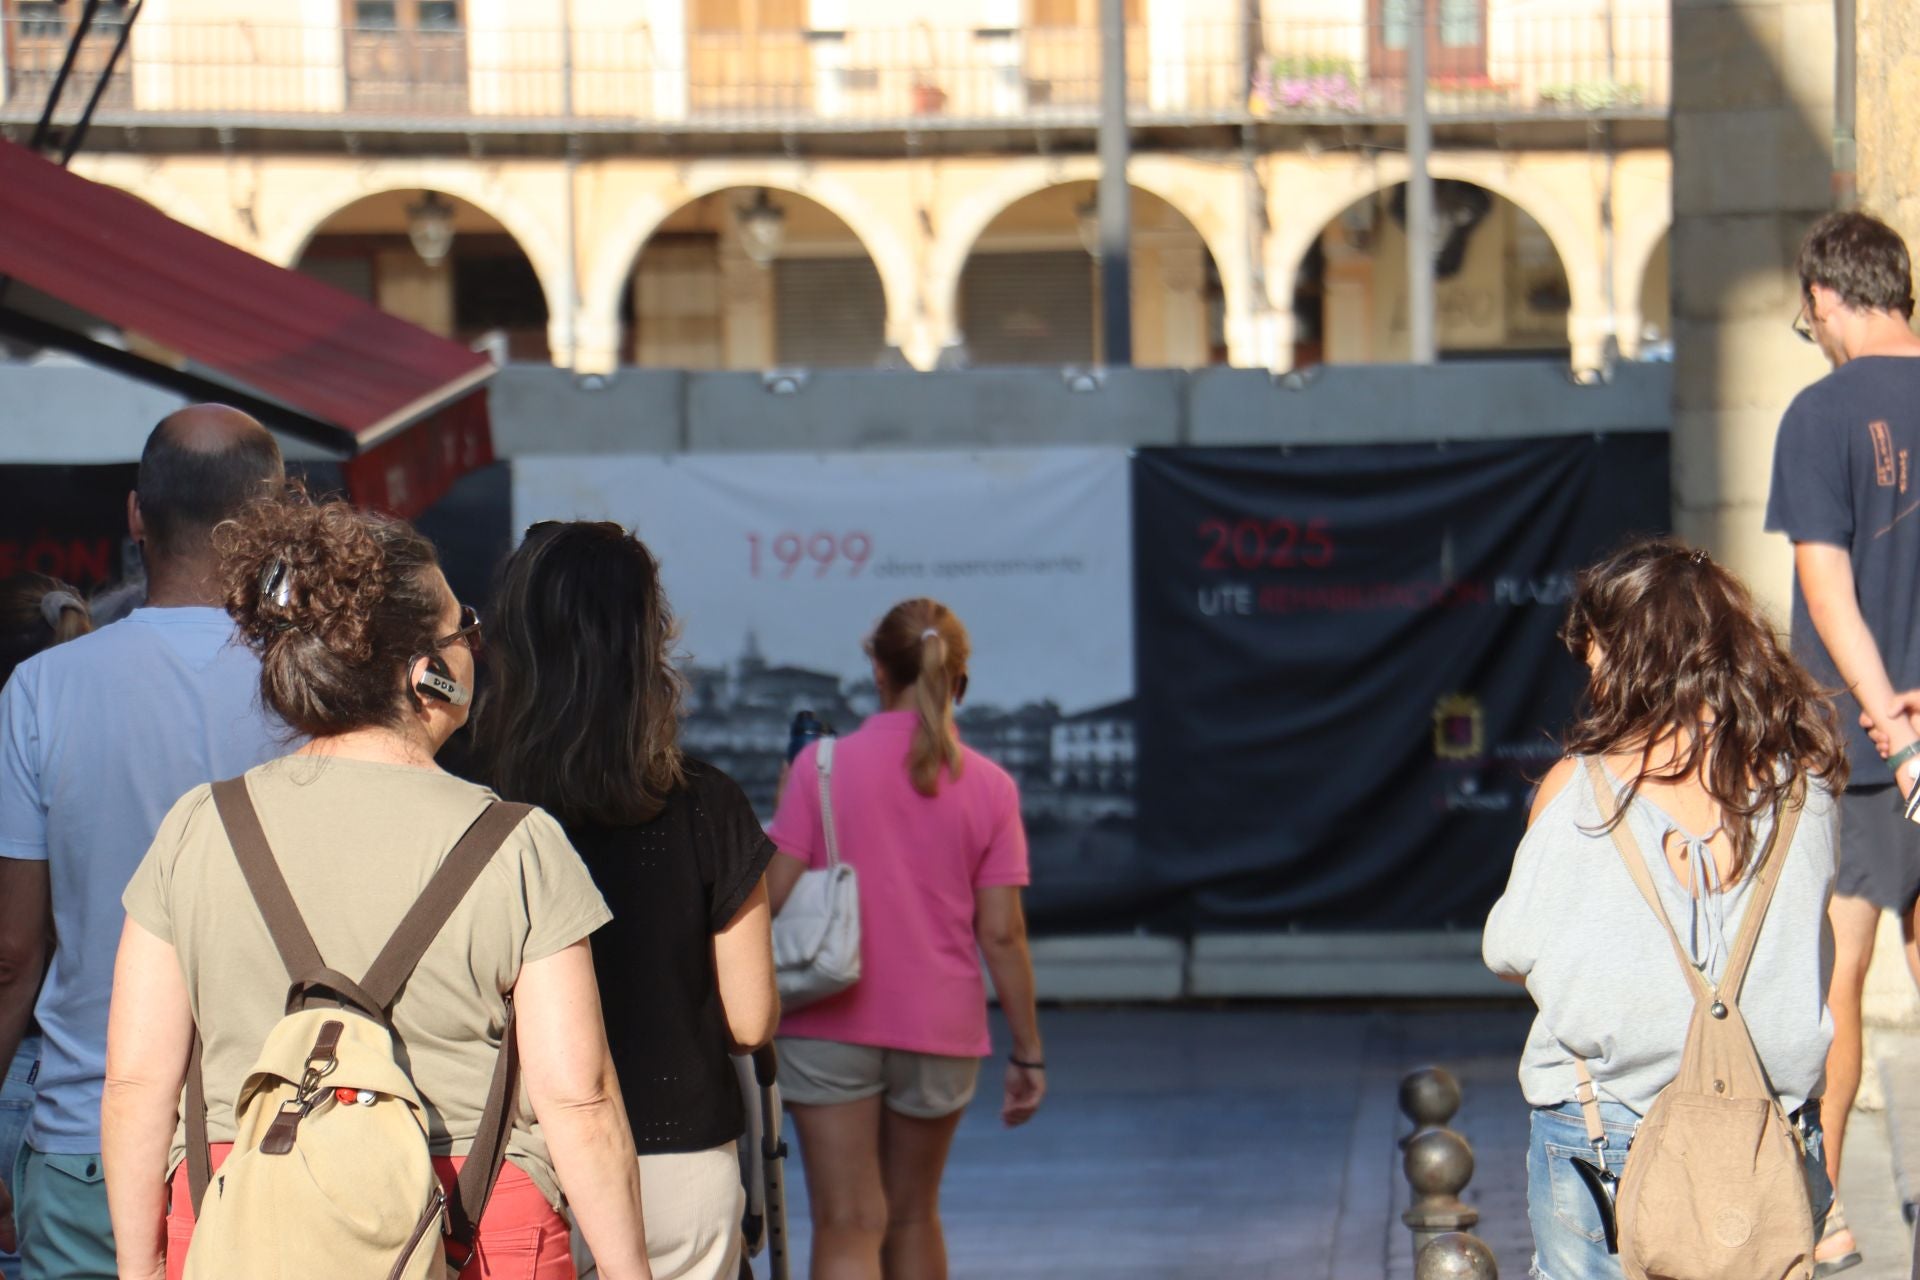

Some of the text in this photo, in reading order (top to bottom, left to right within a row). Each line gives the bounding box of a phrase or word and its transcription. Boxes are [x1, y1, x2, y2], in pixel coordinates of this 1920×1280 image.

[745, 530, 873, 579] 1999
[1199, 519, 1335, 570] 2025
[1198, 584, 1254, 616] UTE
